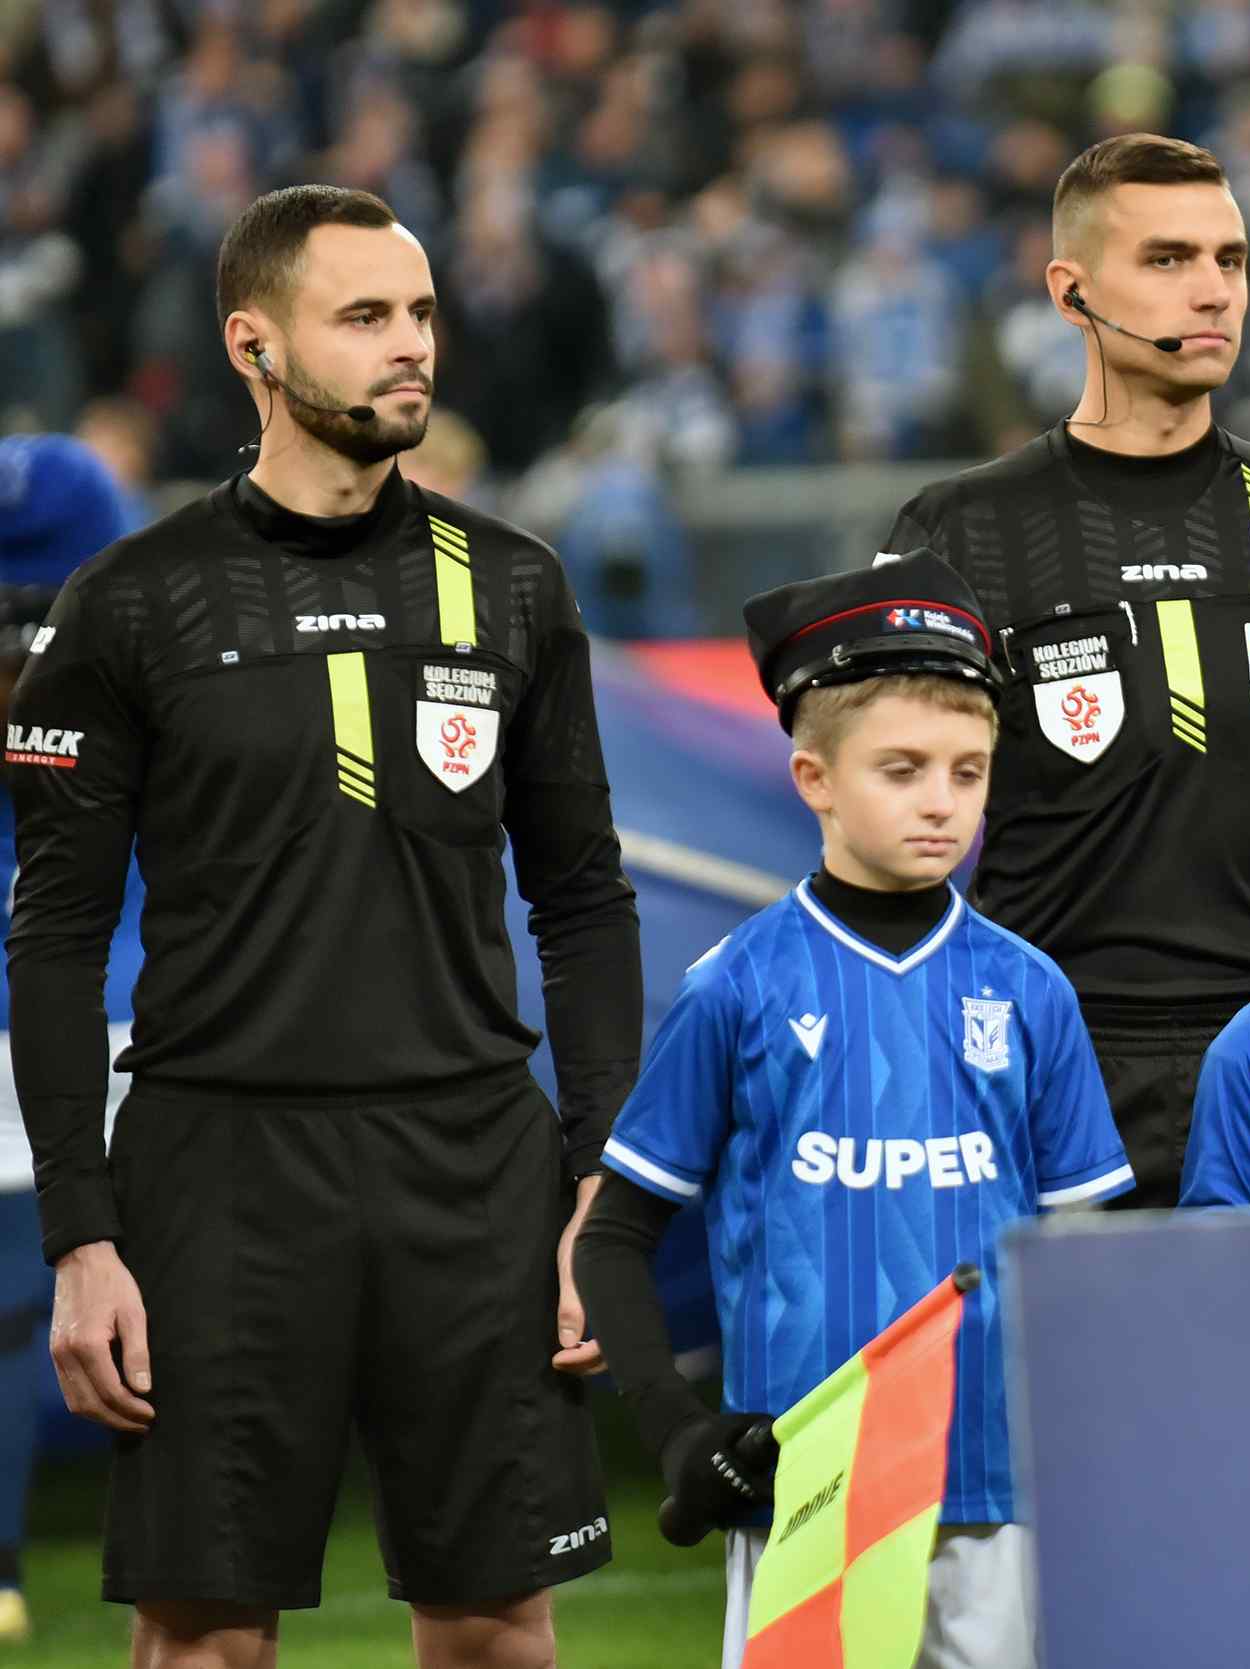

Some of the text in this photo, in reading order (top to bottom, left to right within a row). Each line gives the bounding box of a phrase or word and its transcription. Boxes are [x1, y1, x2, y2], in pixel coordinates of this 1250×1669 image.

[1120, 564, 1208, 581] zina
[295, 613, 387, 632] zina
[1032, 635, 1110, 663] KOLEGIUM
[423, 664, 497, 690] KOLEGIUM
[1039, 652, 1107, 679] SĘDZIÓW
[426, 681, 492, 705] SĘDZIÓW
[1071, 732, 1100, 746] PZPN
[442, 761, 470, 775] PZPN
[790, 1130, 998, 1189] SUPER
[549, 1516, 608, 1555] zina
